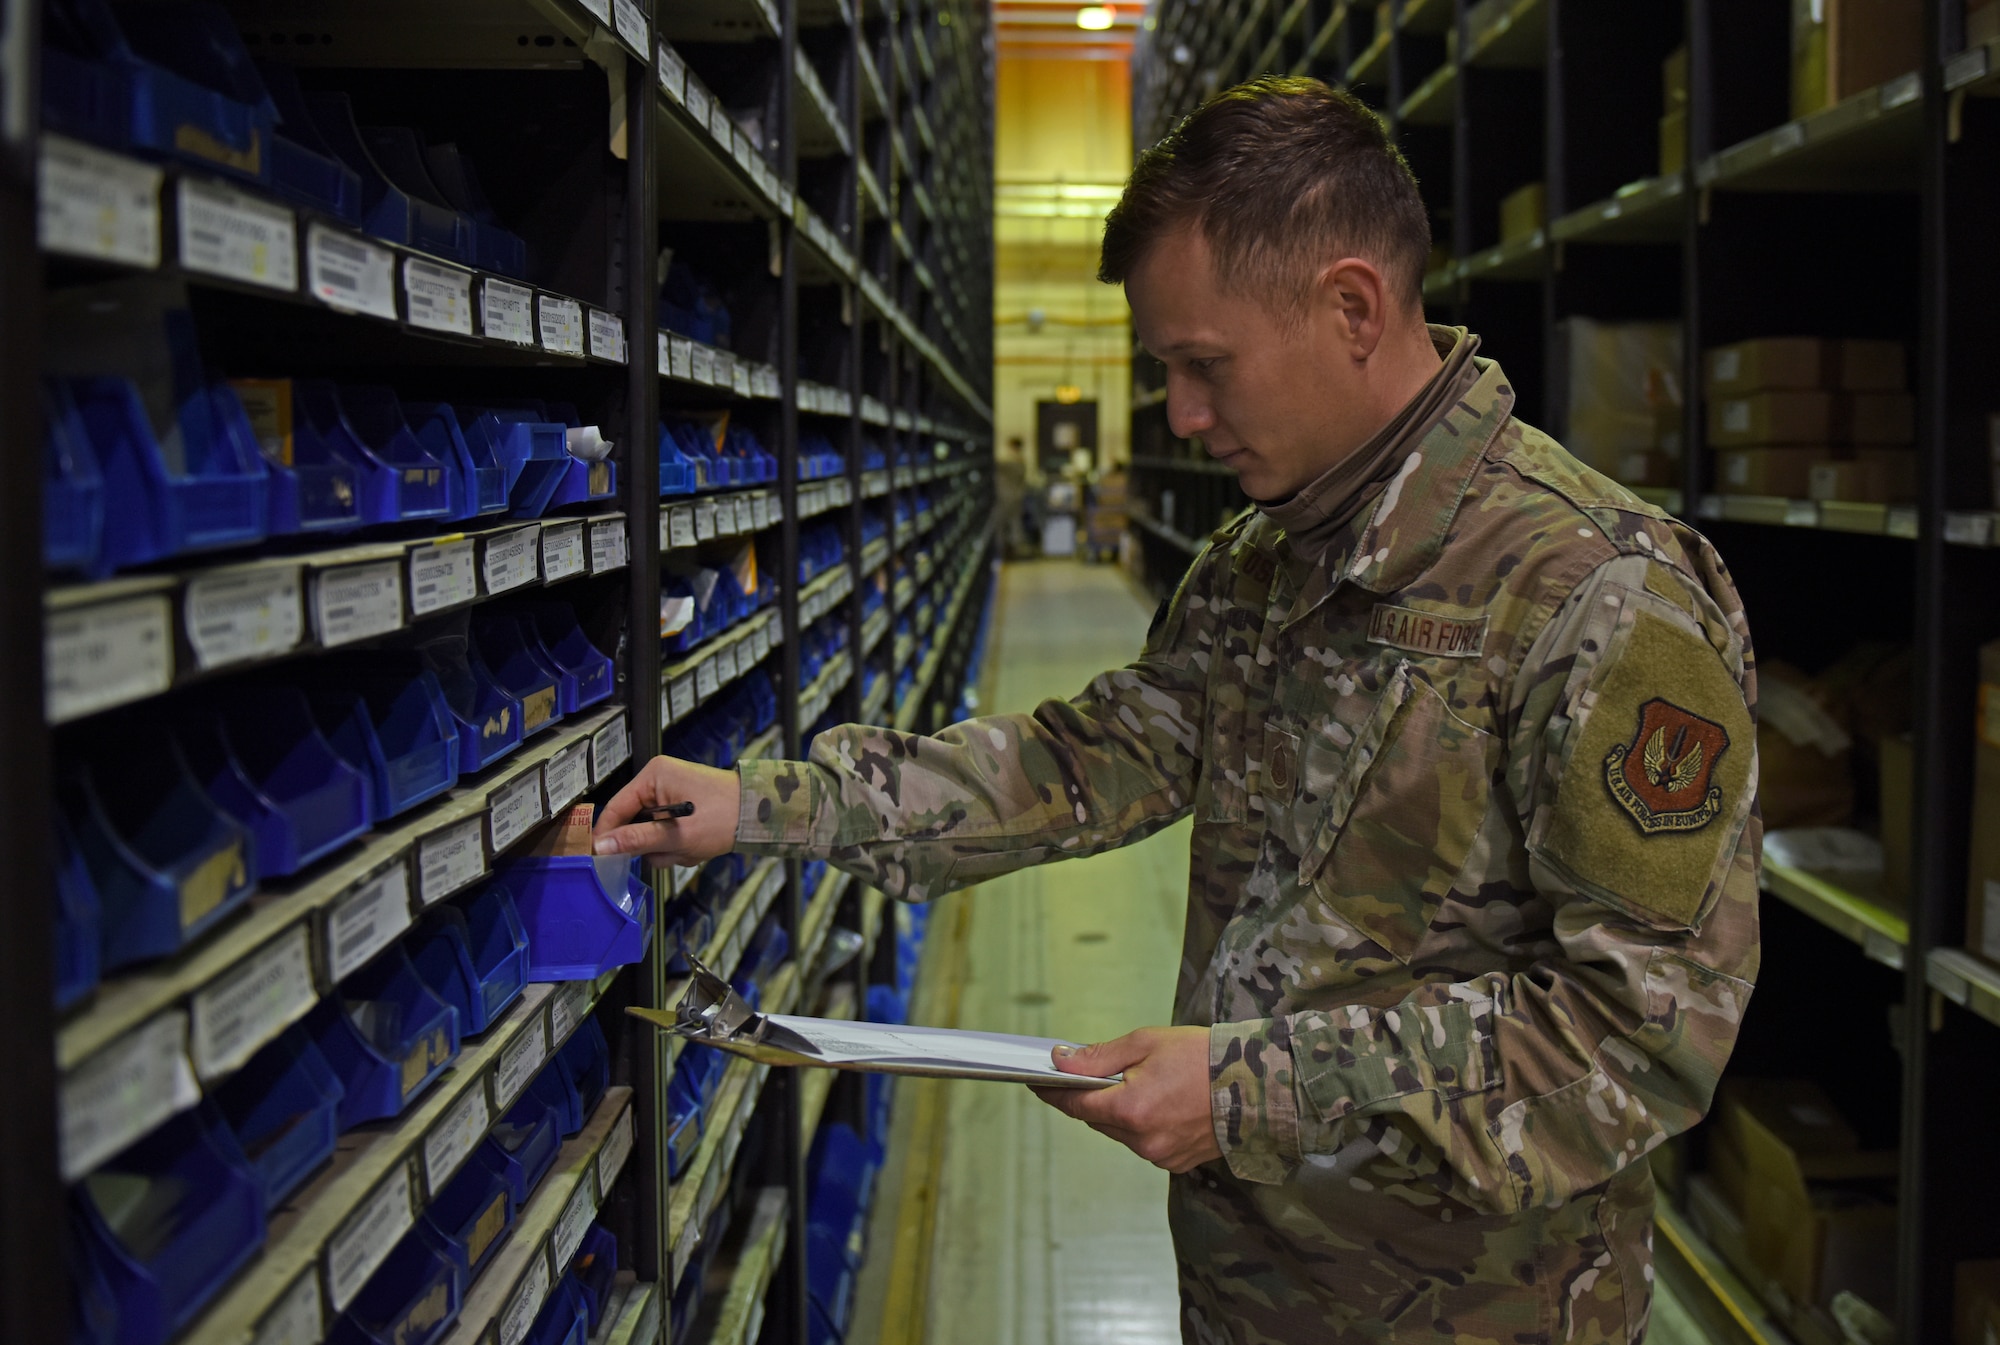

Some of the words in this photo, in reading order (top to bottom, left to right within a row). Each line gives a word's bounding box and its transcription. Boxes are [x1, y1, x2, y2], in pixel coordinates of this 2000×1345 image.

[1397, 615, 1435, 649] AIR
[1616, 785, 1634, 802] AIR
[1631, 797, 1662, 828] FORCES
[1664, 814, 1673, 827] IN
[1676, 804, 1711, 827] EUROPE
